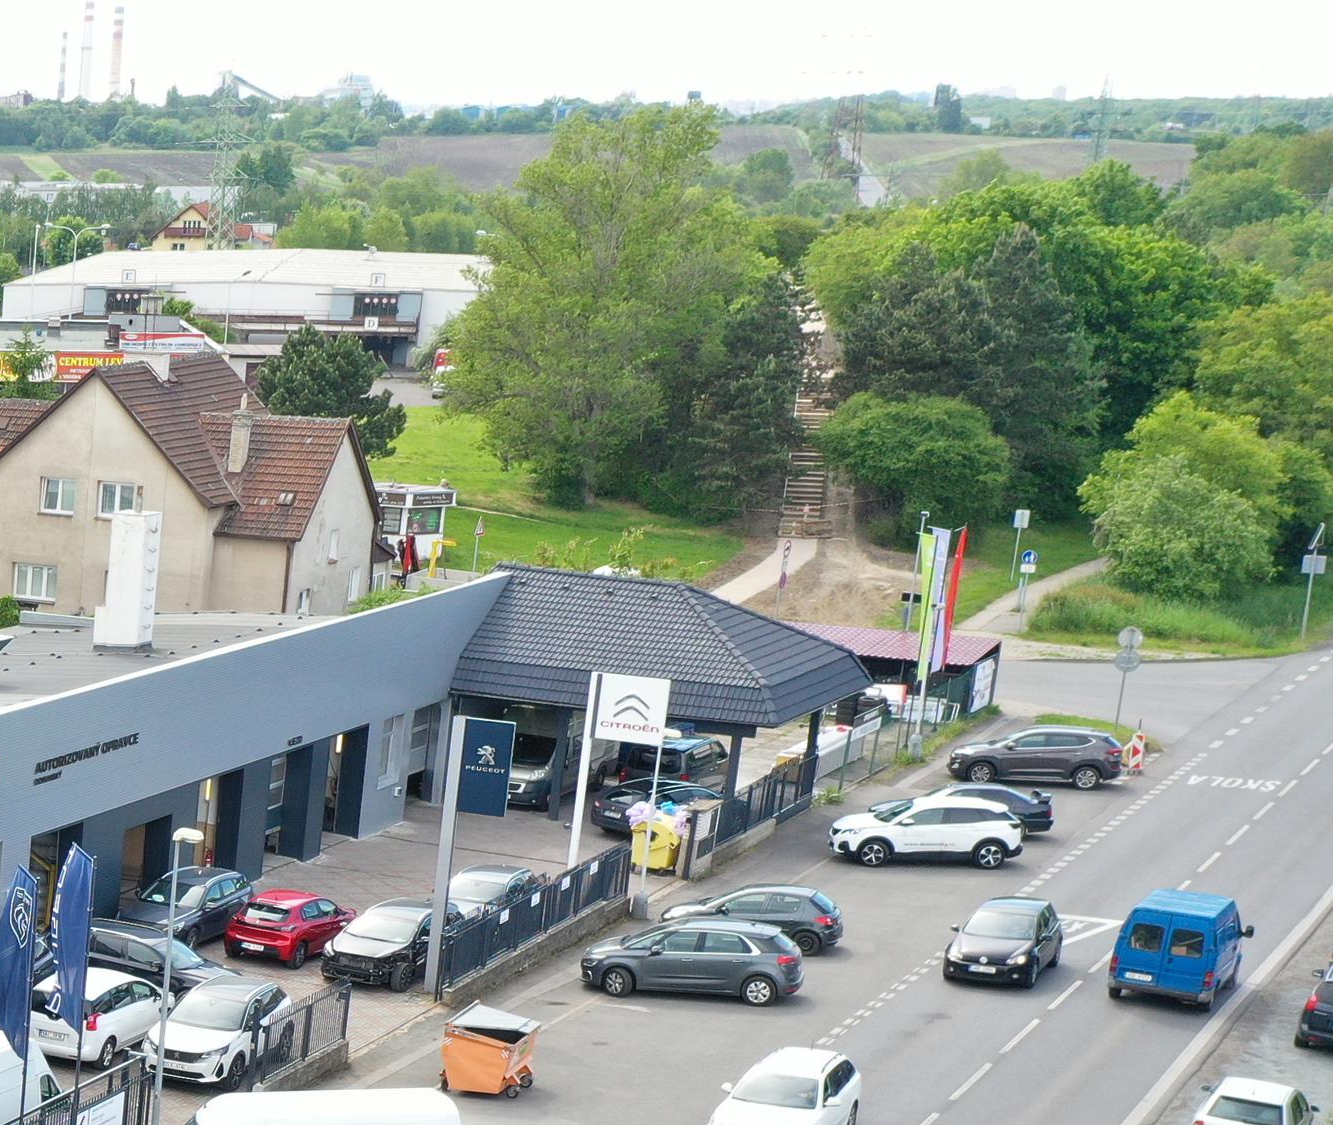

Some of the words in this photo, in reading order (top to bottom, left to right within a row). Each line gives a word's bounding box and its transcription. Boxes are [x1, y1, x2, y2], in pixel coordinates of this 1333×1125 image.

[59, 356, 103, 367] CENTRUM
[34, 741, 101, 775] AUTORIZOVANÝ
[101, 732, 140, 755] OPRAVCE
[465, 765, 506, 774] PEUGEOT
